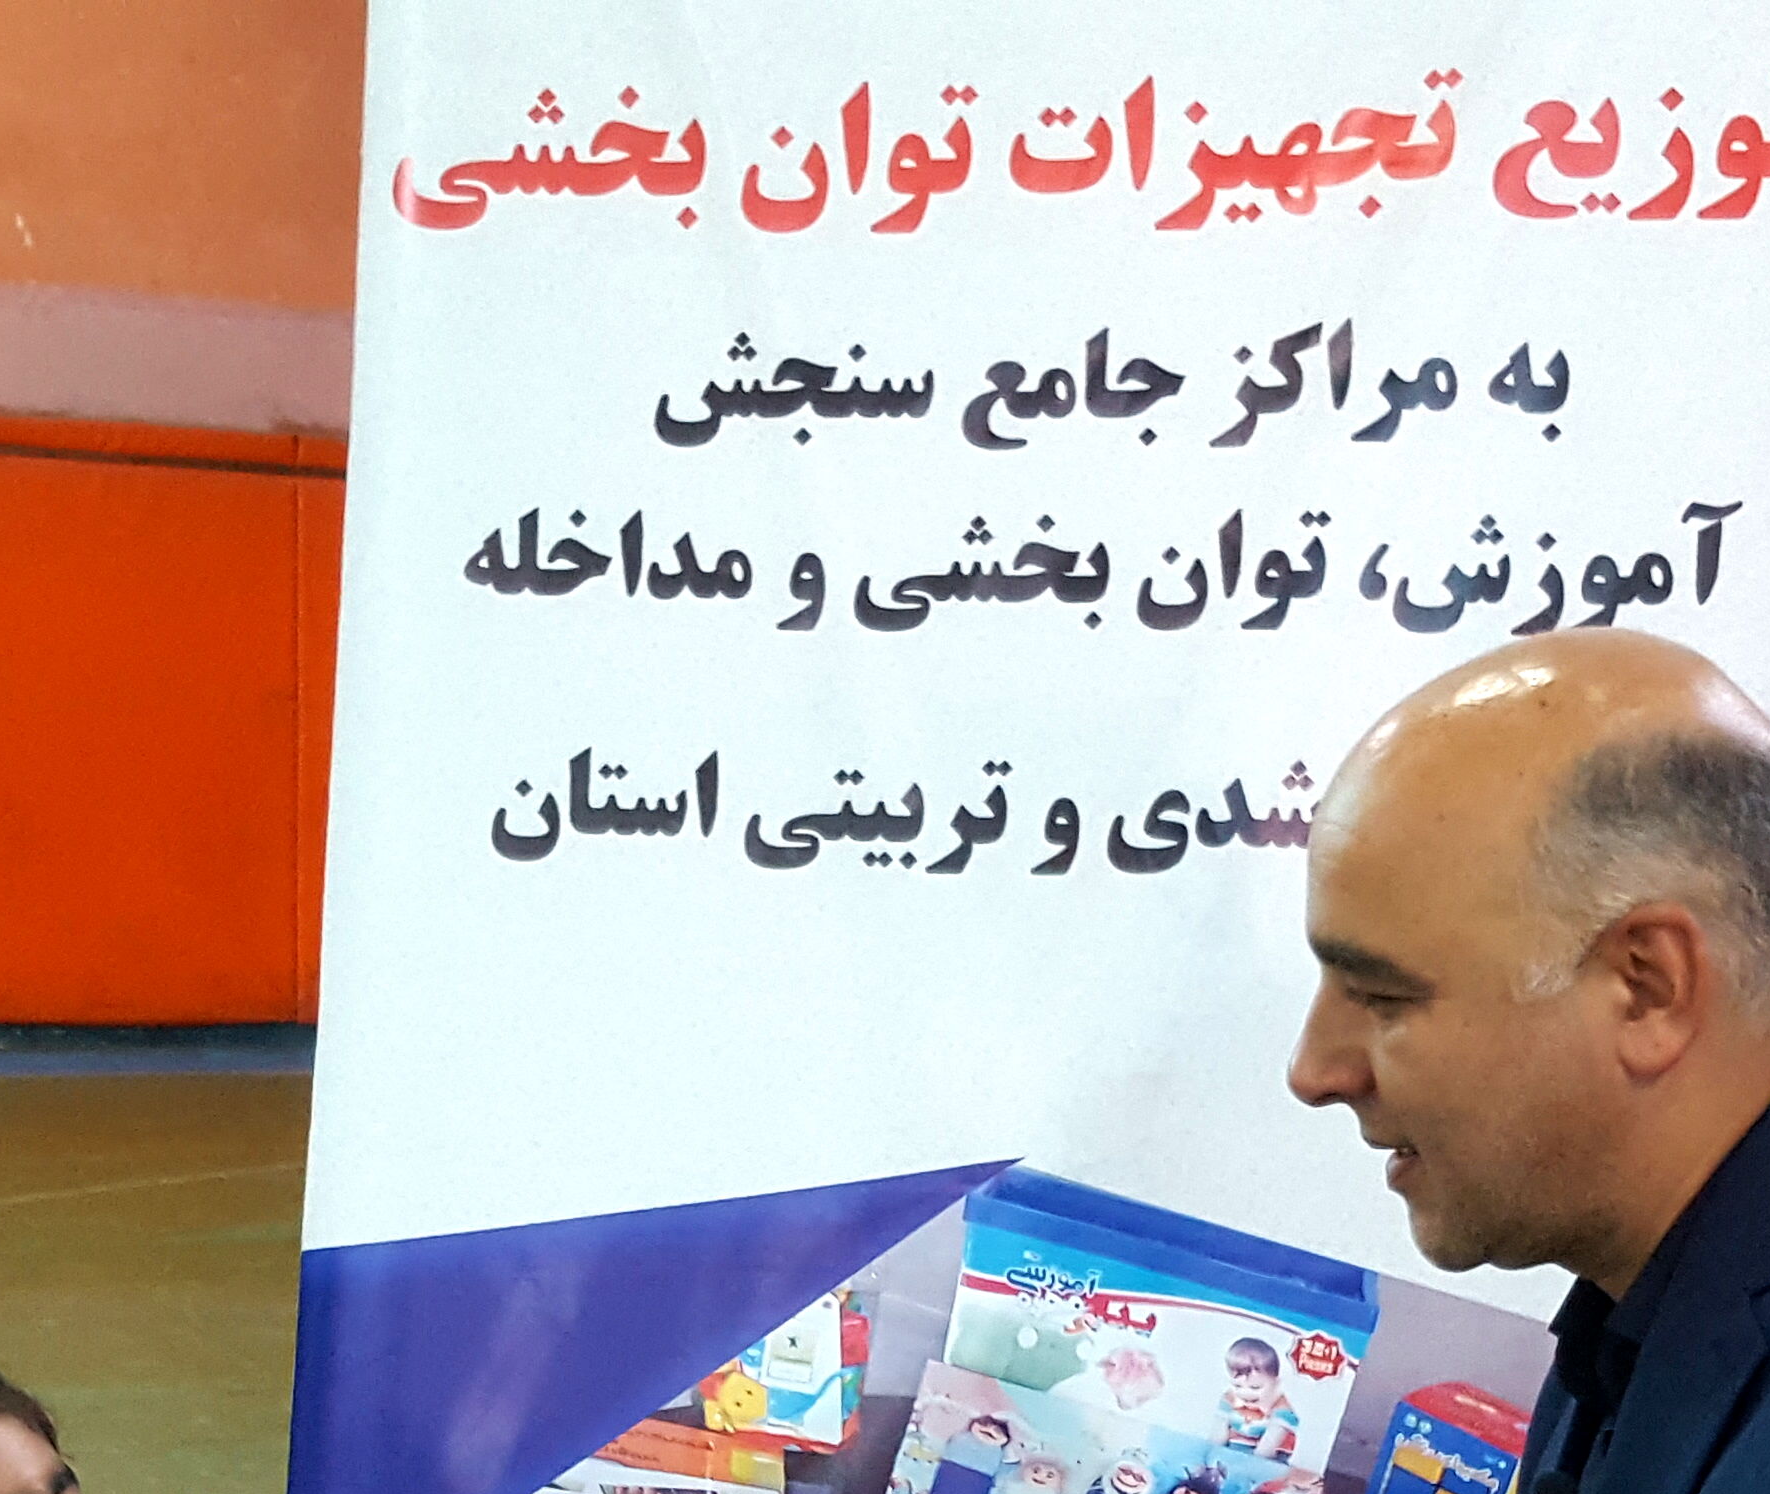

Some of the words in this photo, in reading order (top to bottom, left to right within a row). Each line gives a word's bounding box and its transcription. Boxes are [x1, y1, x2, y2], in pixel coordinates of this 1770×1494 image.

[392, 87, 706, 230] بخشی
[741, 83, 978, 233] توان
[1010, 69, 1462, 230] تجهیزات
[654, 331, 934, 447] سنجش
[962, 327, 1186, 450] جامع
[1209, 318, 1458, 447] مراکز
[1490, 342, 1570, 442] به
[464, 507, 753, 600] مداخله
[776, 552, 826, 631] و
[854, 514, 1110, 632] بخشی
[1137, 508, 1332, 631] توان
[1358, 500, 1743, 636] آموزش،
[491, 747, 719, 861] استان
[744, 760, 1013, 875] تربیتی
[1030, 797, 1080, 875] و
[1107, 759, 1321, 874] شدی
